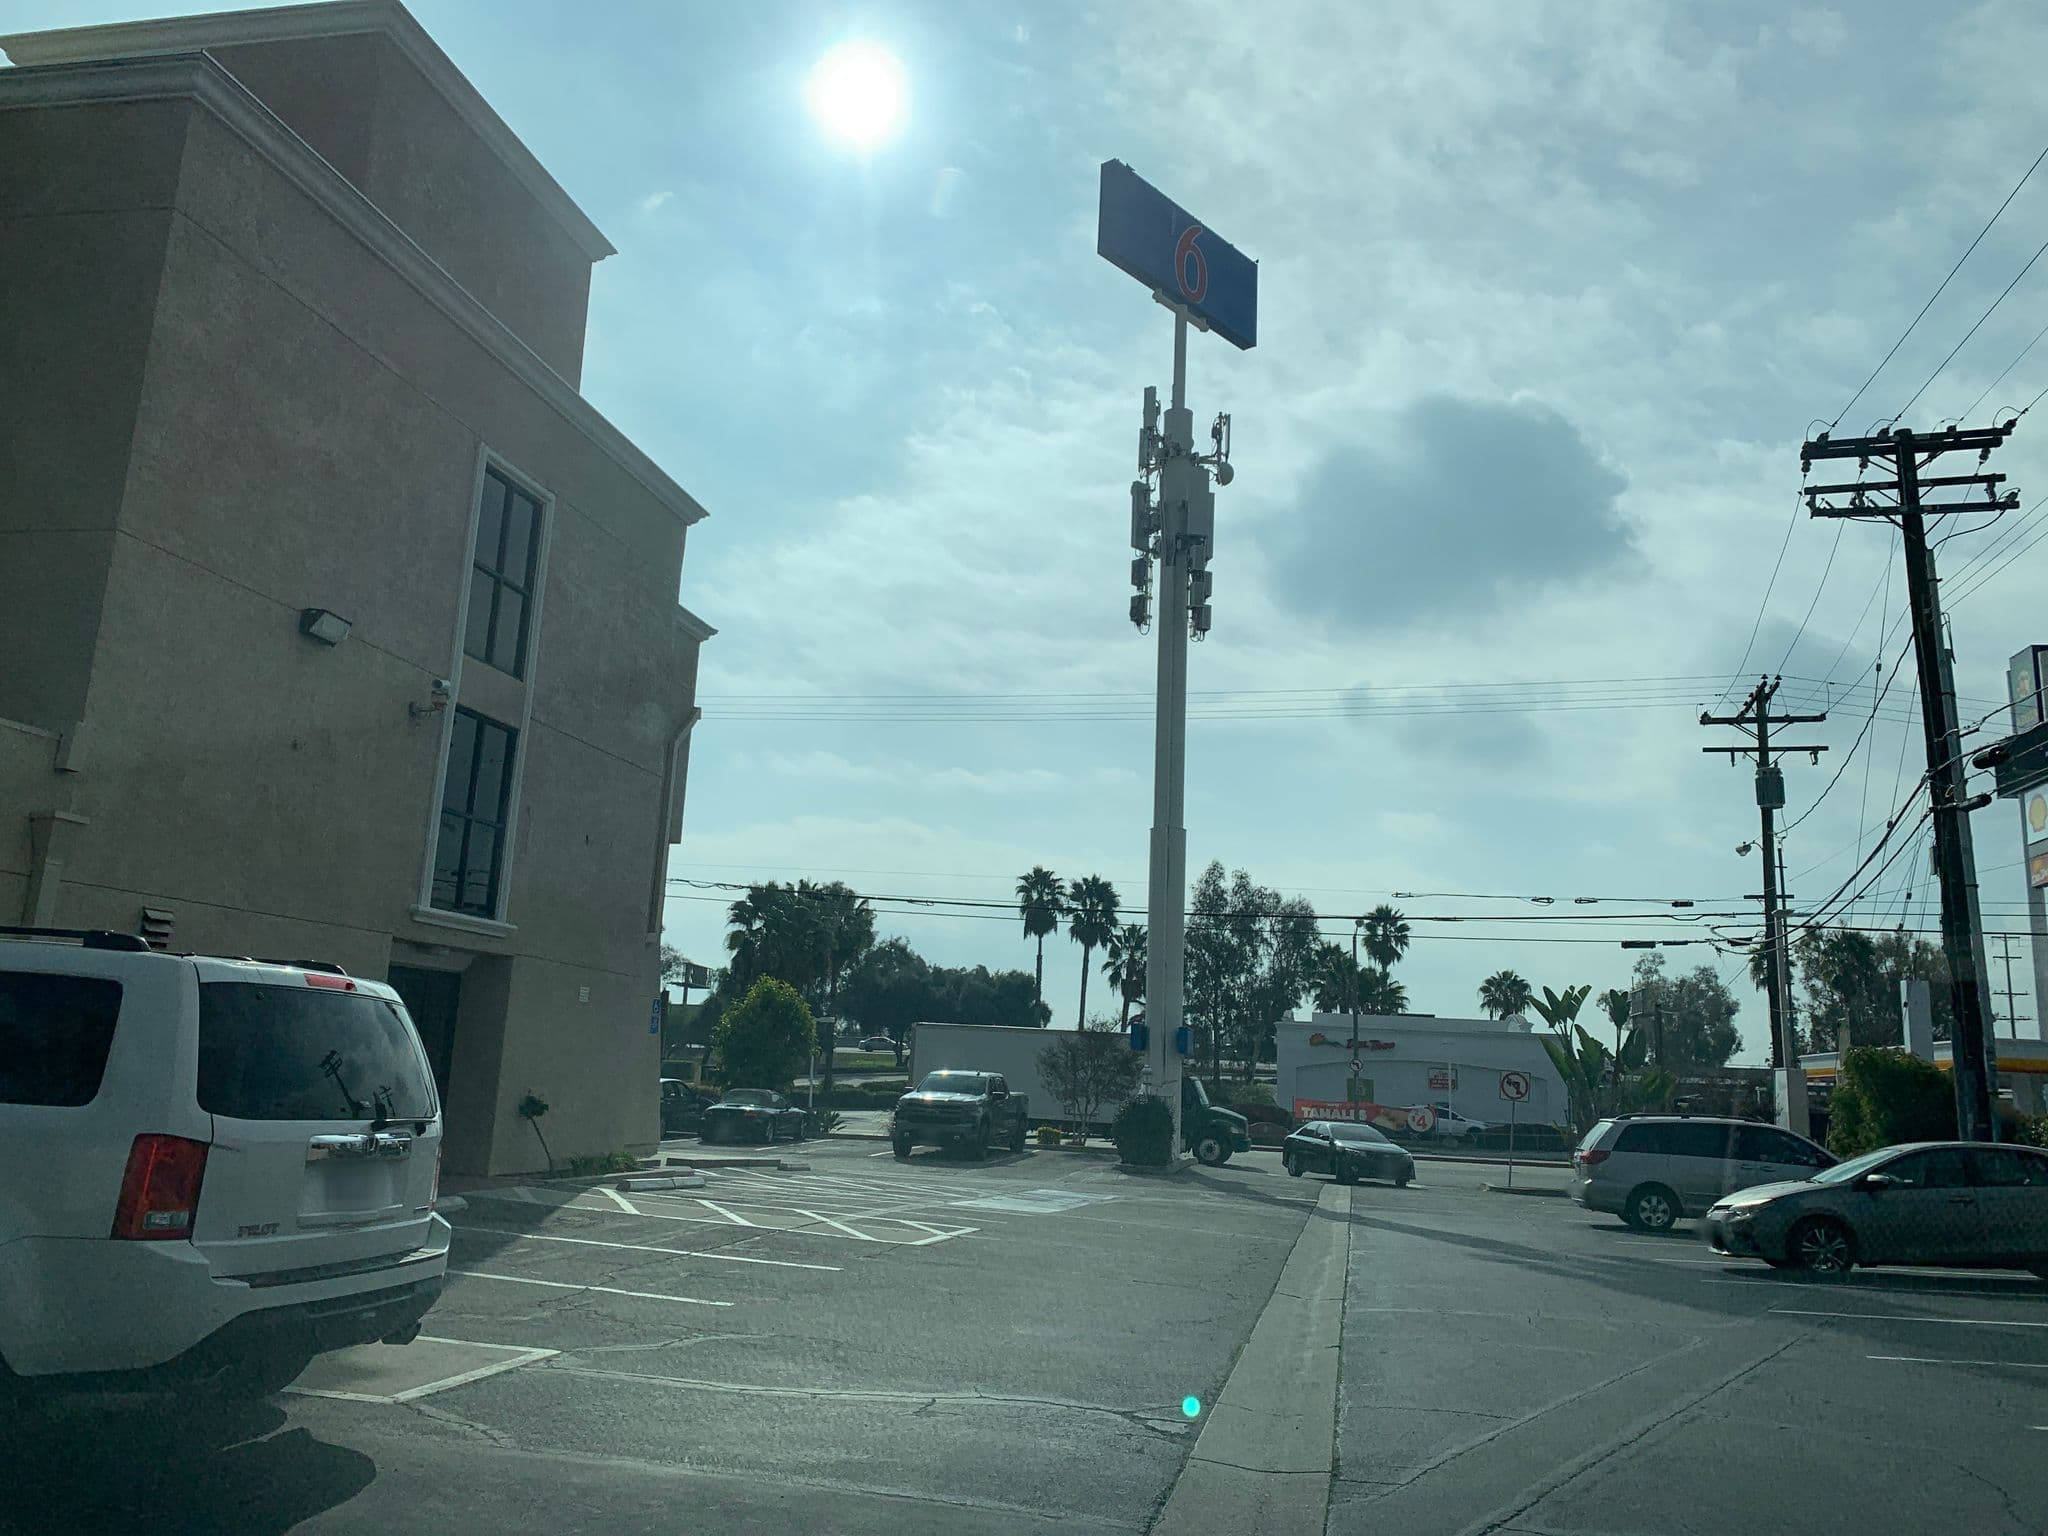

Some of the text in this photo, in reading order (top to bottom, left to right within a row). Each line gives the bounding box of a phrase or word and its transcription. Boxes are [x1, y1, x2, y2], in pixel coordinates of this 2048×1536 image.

[1174, 225, 1208, 304] 6
[1301, 1106, 1368, 1121] TAMALS
[237, 1222, 280, 1238] PILOT
